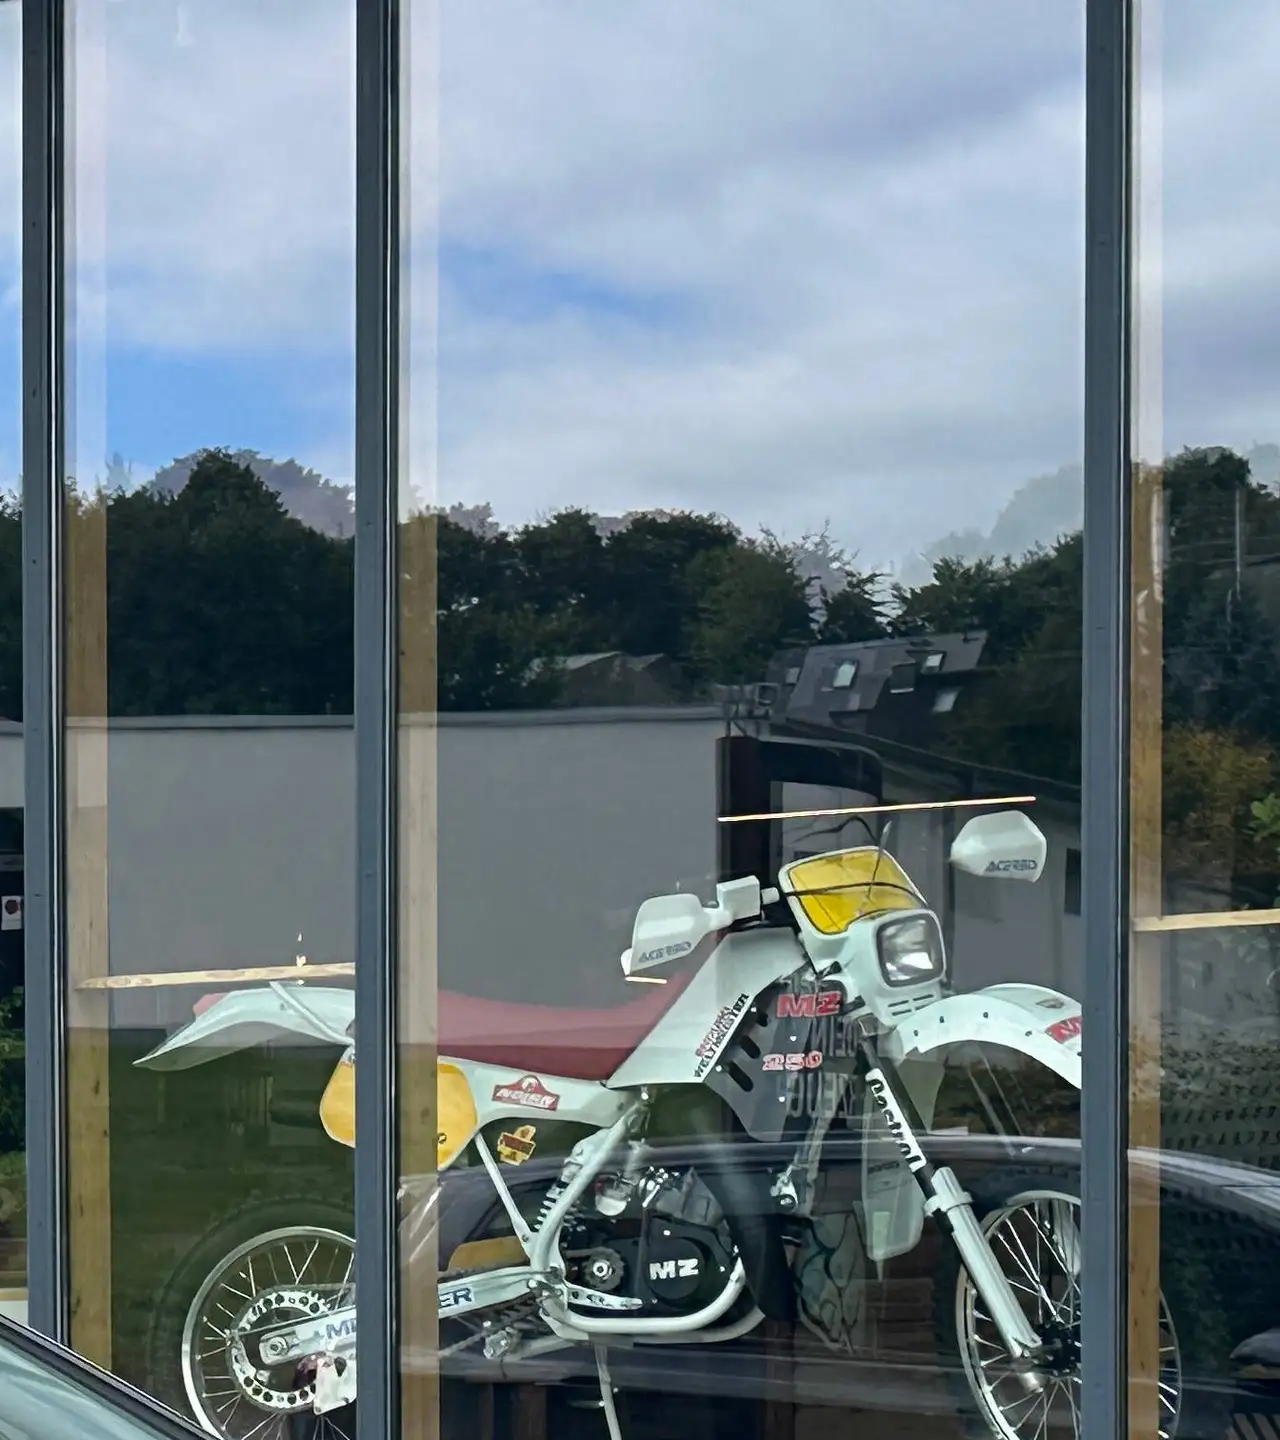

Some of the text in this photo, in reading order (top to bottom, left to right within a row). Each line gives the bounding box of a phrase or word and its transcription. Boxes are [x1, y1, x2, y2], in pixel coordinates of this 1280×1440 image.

[776, 991, 842, 1018] MZ
[762, 1051, 823, 1071] 250
[866, 1079, 923, 1164] Castrol
[649, 1258, 699, 1280] MZ
